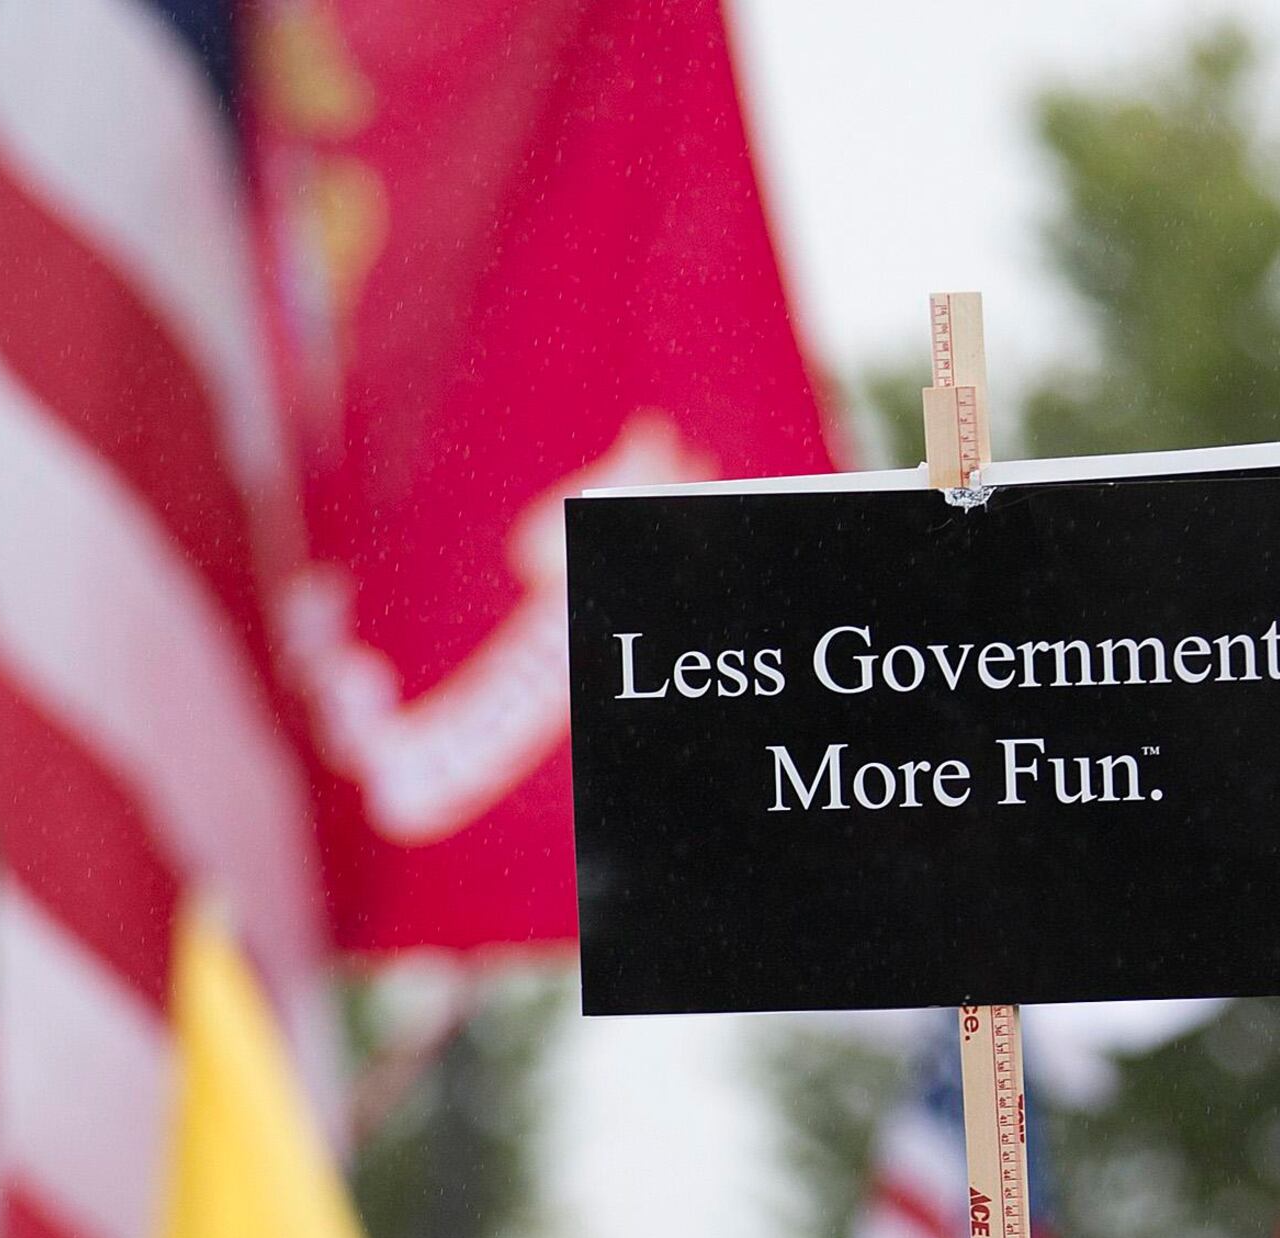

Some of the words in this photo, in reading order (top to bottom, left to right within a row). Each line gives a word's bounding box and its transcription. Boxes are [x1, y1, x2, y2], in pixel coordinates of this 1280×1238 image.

[611, 631, 786, 700] Less
[764, 742, 971, 813] More
[970, 1187, 992, 1237] ACE
